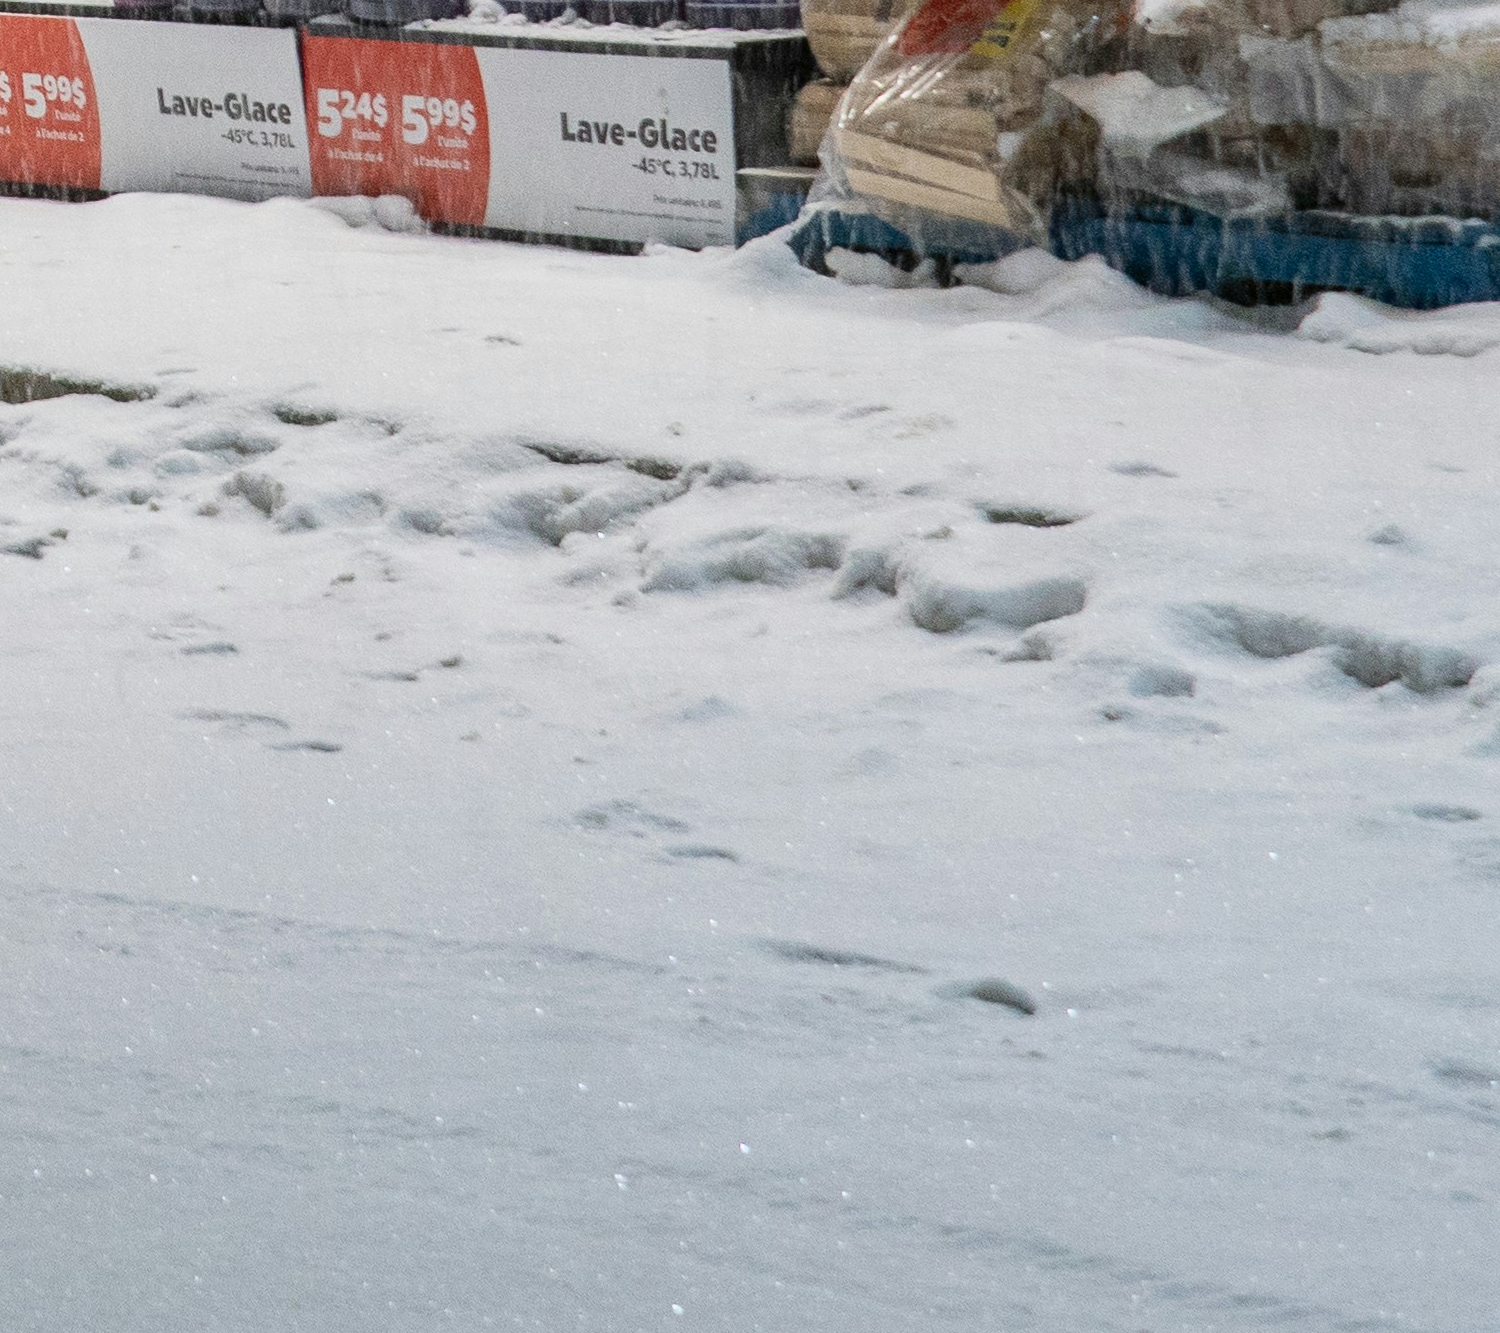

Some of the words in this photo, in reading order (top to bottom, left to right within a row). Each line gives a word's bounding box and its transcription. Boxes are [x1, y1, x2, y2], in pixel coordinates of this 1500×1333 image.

[21, 72, 87, 119] 599$
[156, 87, 292, 125] Lave-Glace
[316, 87, 388, 138] 524$
[402, 94, 477, 146] 599$
[560, 111, 718, 154] Lave-Glace
[260, 130, 296, 149] 3,78L
[678, 161, 720, 181] 3,78L
